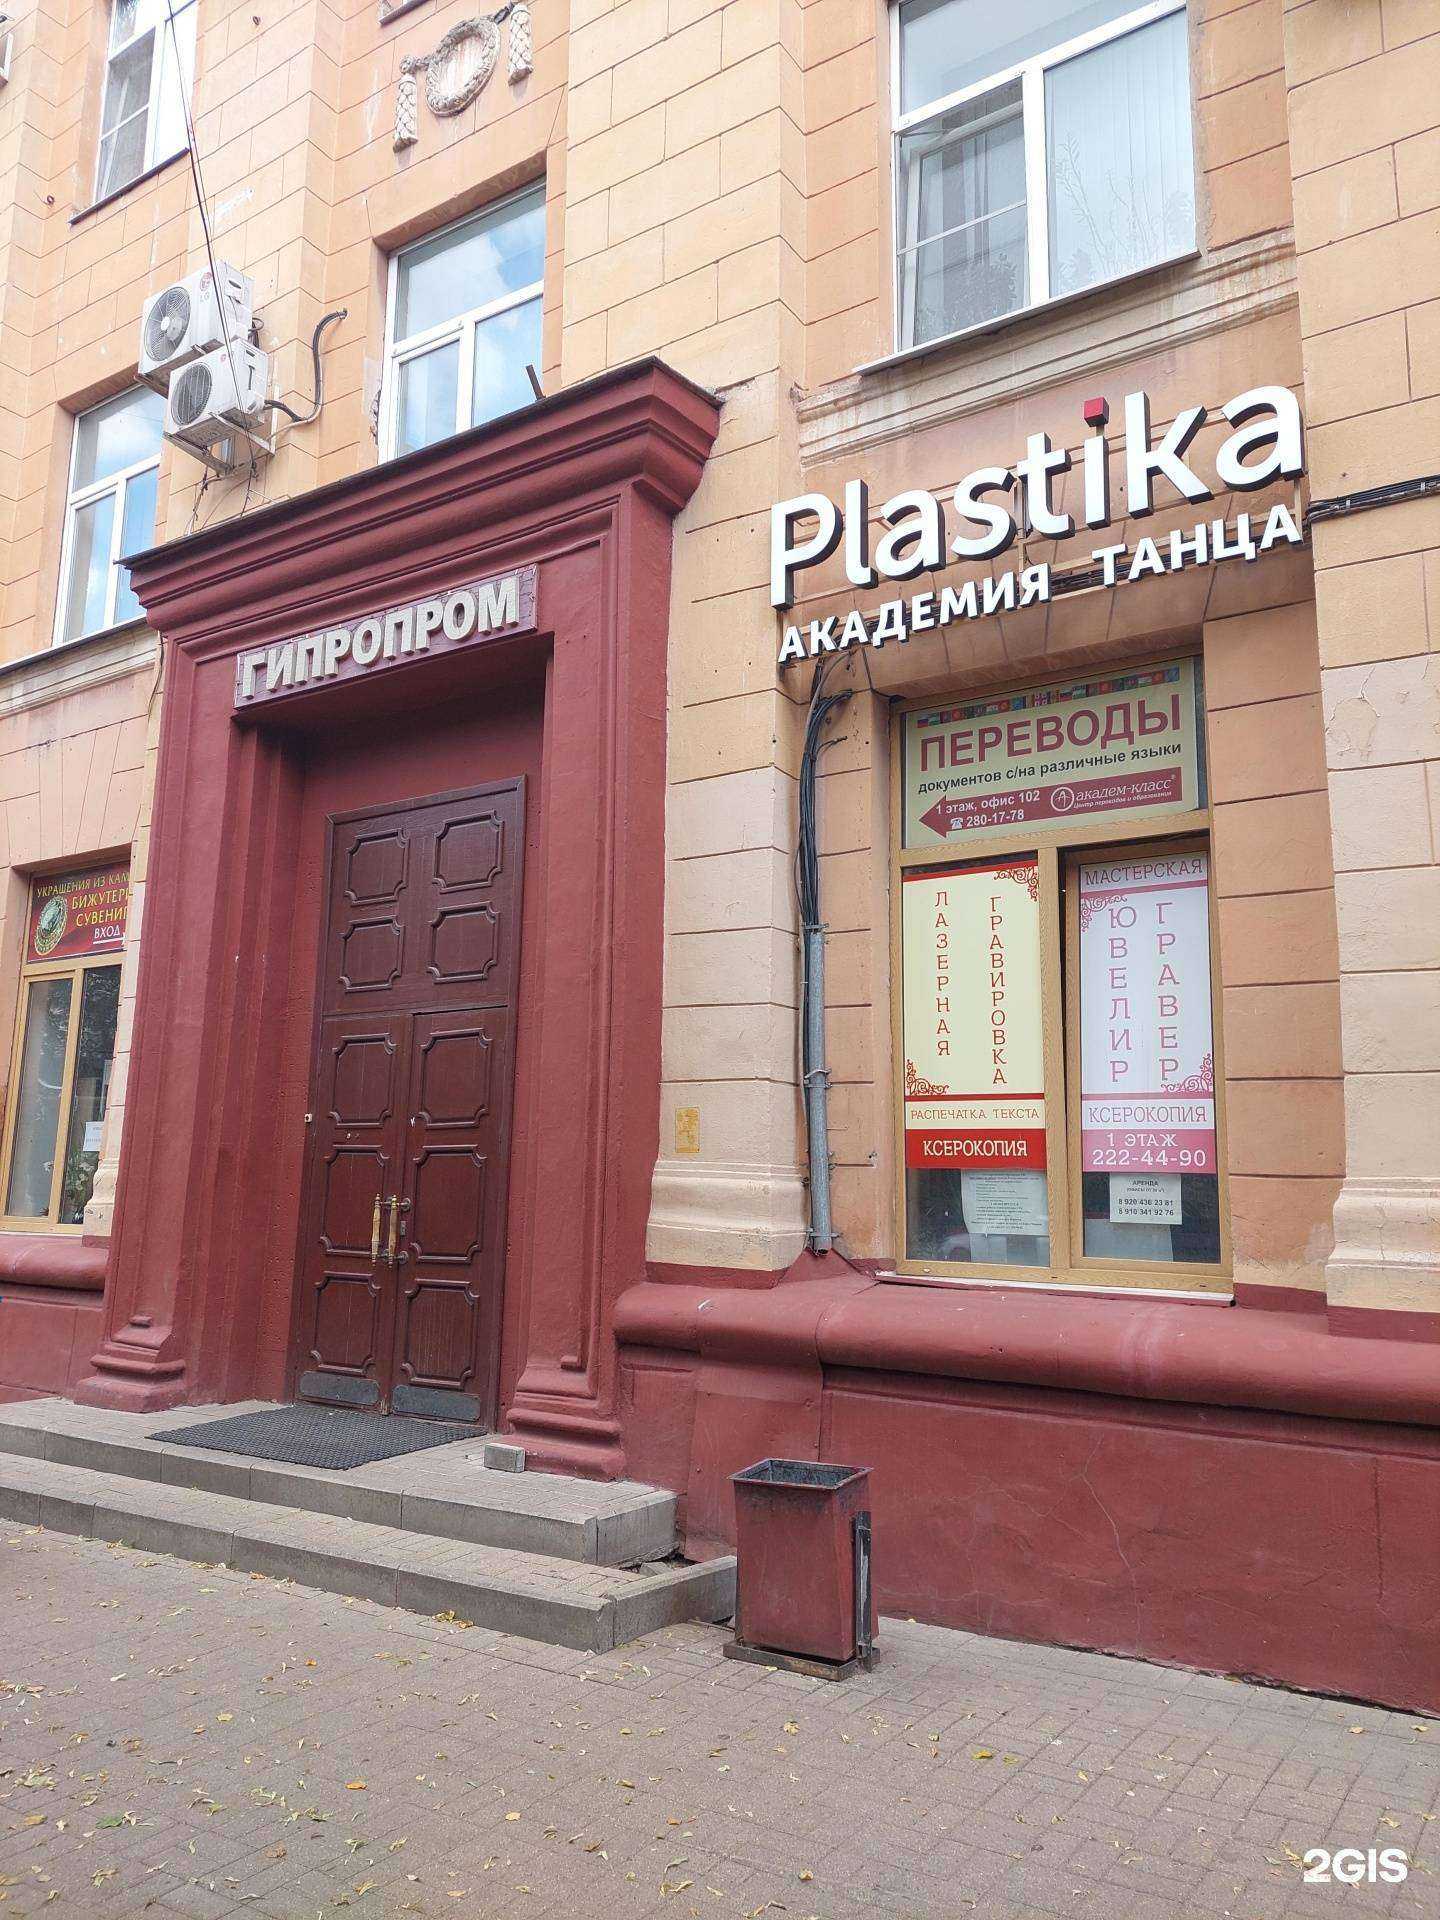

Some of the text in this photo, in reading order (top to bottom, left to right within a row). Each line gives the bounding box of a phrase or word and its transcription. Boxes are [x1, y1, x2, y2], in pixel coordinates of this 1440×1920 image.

[770, 385, 1304, 611] Plastika
[778, 503, 1303, 665] АКАДЕМИЯ ТАНЦА
[242, 575, 520, 699] ГИПРОПРОМ
[920, 693, 1181, 771] ПЕРЕВОДЫ
[918, 743, 1181, 794] документов с/на различные языки
[936, 789, 1040, 815] 1 этаж, офис 102
[966, 809, 1024, 827] 280-17-78
[1085, 859, 1203, 886] МАСТЕРСКАЯ
[37, 879, 90, 898] УКРАШЕНИЯ
[94, 876, 105, 888] ИЗ
[94, 925, 120, 939] ВХОД
[934, 891, 950, 1057] ЛАЗЕРНАЯ
[989, 896, 1007, 1085] ГРАВИРОВКА
[1108, 906, 1137, 1083] ЮВЕЛИР
[1156, 902, 1180, 1081] ГРАВЕР
[911, 1107, 1040, 1120] РАСПЕЧАТКА ТЕКСТА
[1088, 1106, 1207, 1123] КСЕРОКОПИЯ
[922, 1139, 1027, 1157] КСЕРОКОПИЯ
[1107, 1133, 1178, 1147] 1 ЭТАЖ
[1092, 1149, 1206, 1167] 222-44-90
